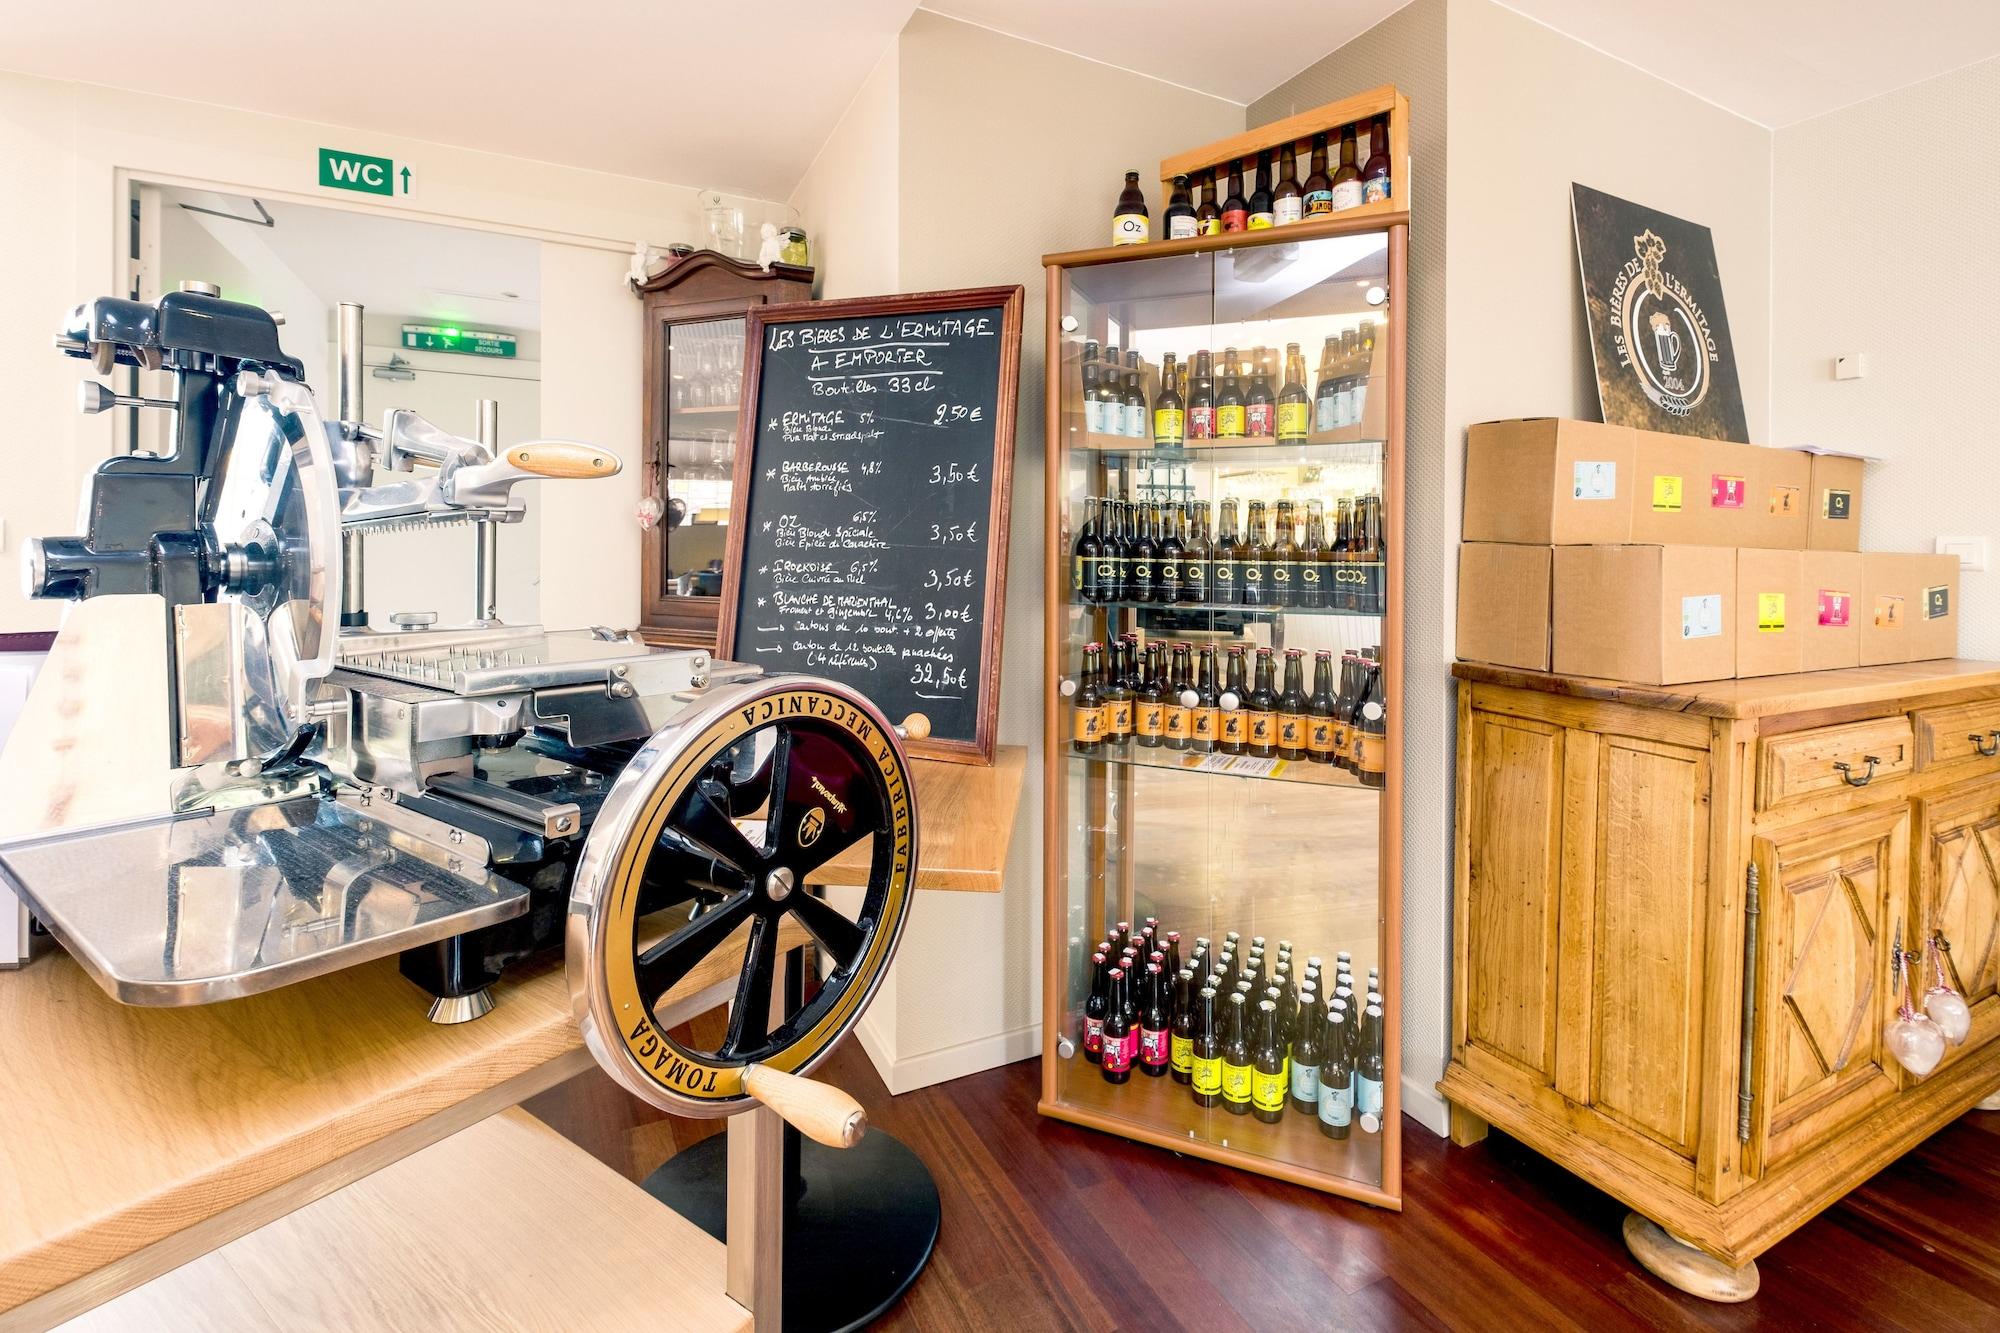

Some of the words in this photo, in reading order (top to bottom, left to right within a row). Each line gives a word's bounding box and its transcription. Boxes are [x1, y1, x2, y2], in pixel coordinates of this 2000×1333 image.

[328, 157, 384, 186] WC
[1123, 220, 1142, 233] Oz
[1626, 257, 1641, 278] DE
[1609, 271, 1631, 328] BIÈRES
[1665, 272, 1718, 363] L'ERMITAGE
[478, 339, 500, 347] SORTIE
[769, 327, 794, 350] LES
[853, 327, 872, 340] DE
[474, 346, 504, 355] SECOURS
[835, 349, 932, 368] EMPORTER
[1616, 335, 1632, 368] LES
[812, 382, 877, 396] Bouteilles
[888, 380, 910, 393] 33
[915, 376, 936, 392] cl
[860, 410, 875, 424] 5%
[782, 461, 849, 473] BARBEROUSSE
[862, 461, 882, 476] 4,8%
[852, 510, 878, 523] 6,5%
[850, 559, 878, 576] 6,5%
[1136, 565, 1152, 578] Oz
[1163, 566, 1179, 578] Oz
[1189, 567, 1204, 579] Oz
[1217, 567, 1234, 580] Oz
[1246, 568, 1263, 581] Oz
[1274, 568, 1290, 581] Oz
[1303, 569, 1320, 582] Oz
[773, 591, 816, 605] BLANCHE
[823, 595, 834, 606] DE
[815, 607, 824, 615] et
[885, 607, 913, 623] 4,6%
[836, 623, 850, 631] de
[915, 625, 923, 636] 2
[925, 625, 957, 644] offerts
[829, 642, 842, 652] de
[845, 643, 860, 652] 12
[902, 646, 953, 663] panachées
[742, 695, 873, 741] MECCANICA
[878, 745, 908, 873] FABBRICA
[630, 1017, 718, 1092] TOMAGA
